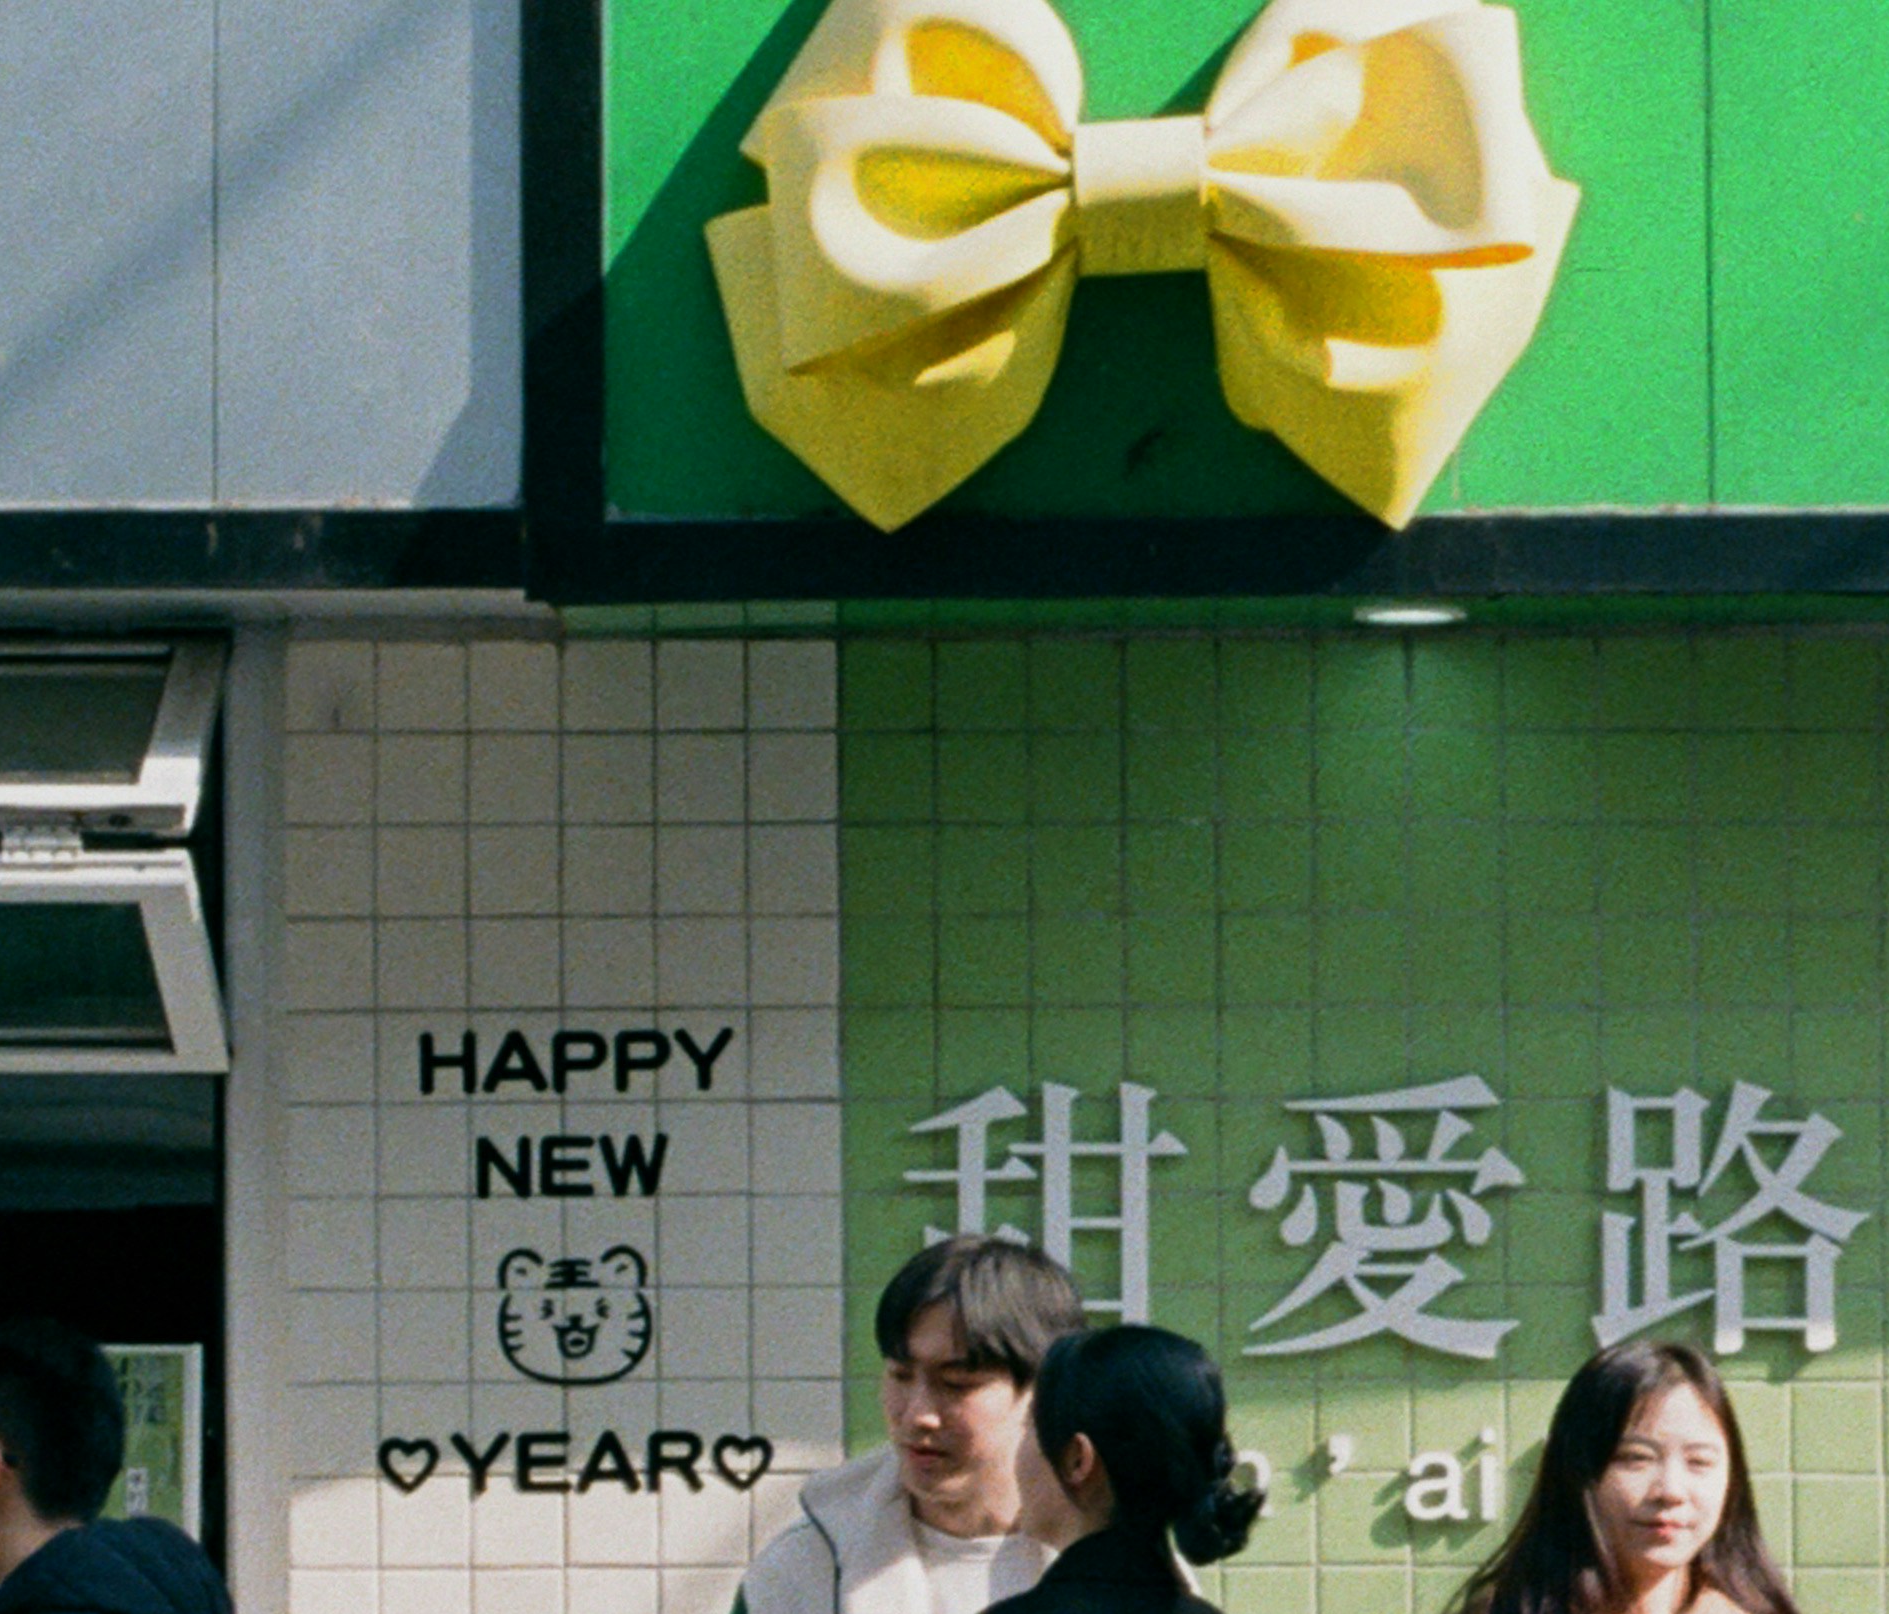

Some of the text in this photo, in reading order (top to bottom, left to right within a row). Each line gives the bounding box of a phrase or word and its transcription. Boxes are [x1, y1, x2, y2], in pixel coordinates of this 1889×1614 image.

[418, 1027, 734, 1096] HAPPY
[475, 1132, 669, 1199] NEW
[903, 1074, 1870, 1360] 甜愛路
[449, 1430, 706, 1496] YEAR
